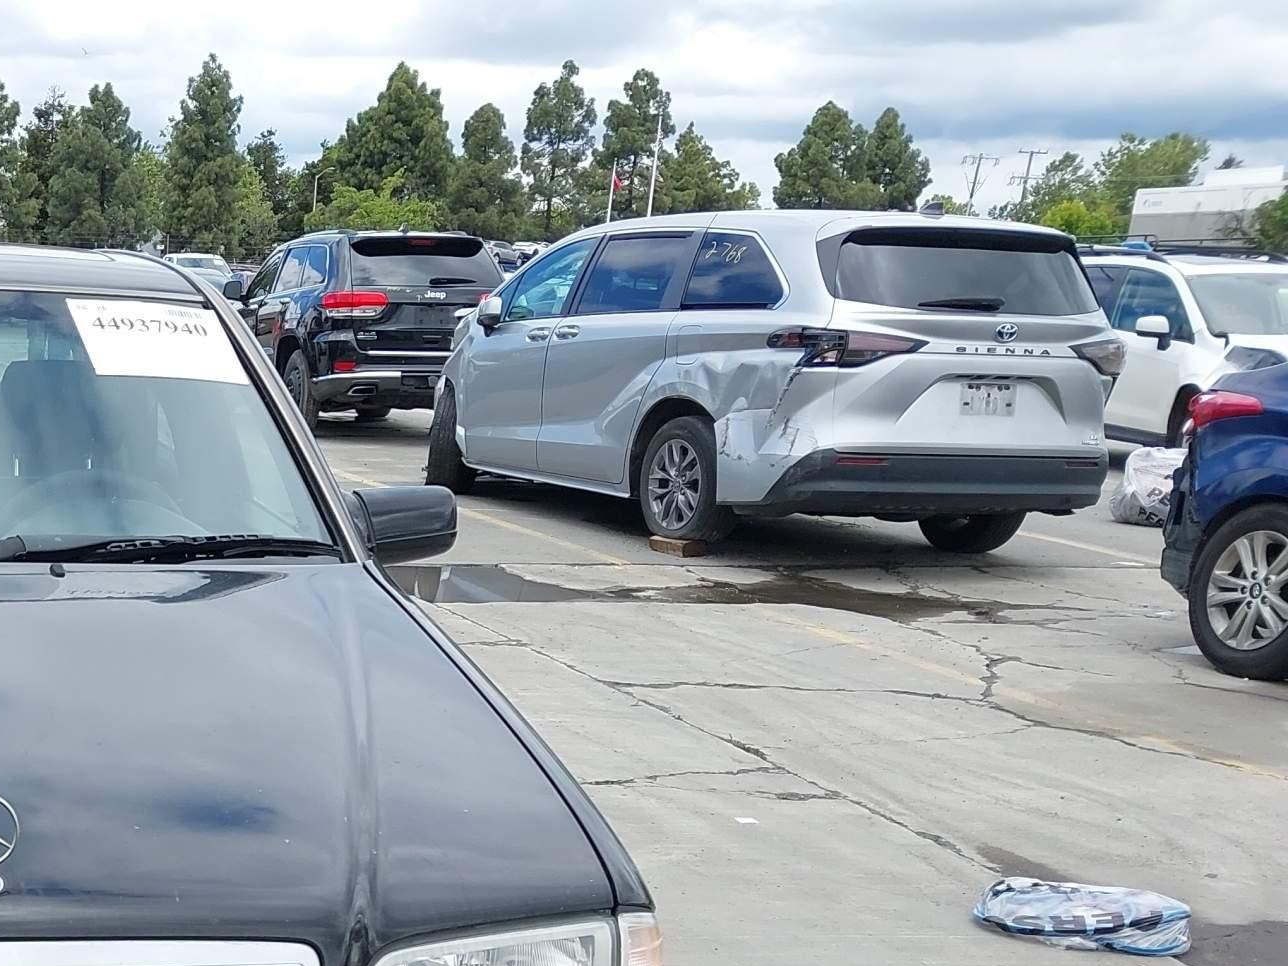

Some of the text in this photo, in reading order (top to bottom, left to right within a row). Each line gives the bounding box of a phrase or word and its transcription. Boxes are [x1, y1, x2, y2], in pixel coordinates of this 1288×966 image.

[705, 240, 748, 264] 2768
[424, 290, 447, 300] Jeep
[91, 315, 208, 337] 44937940
[955, 346, 1051, 356] SIENNA
